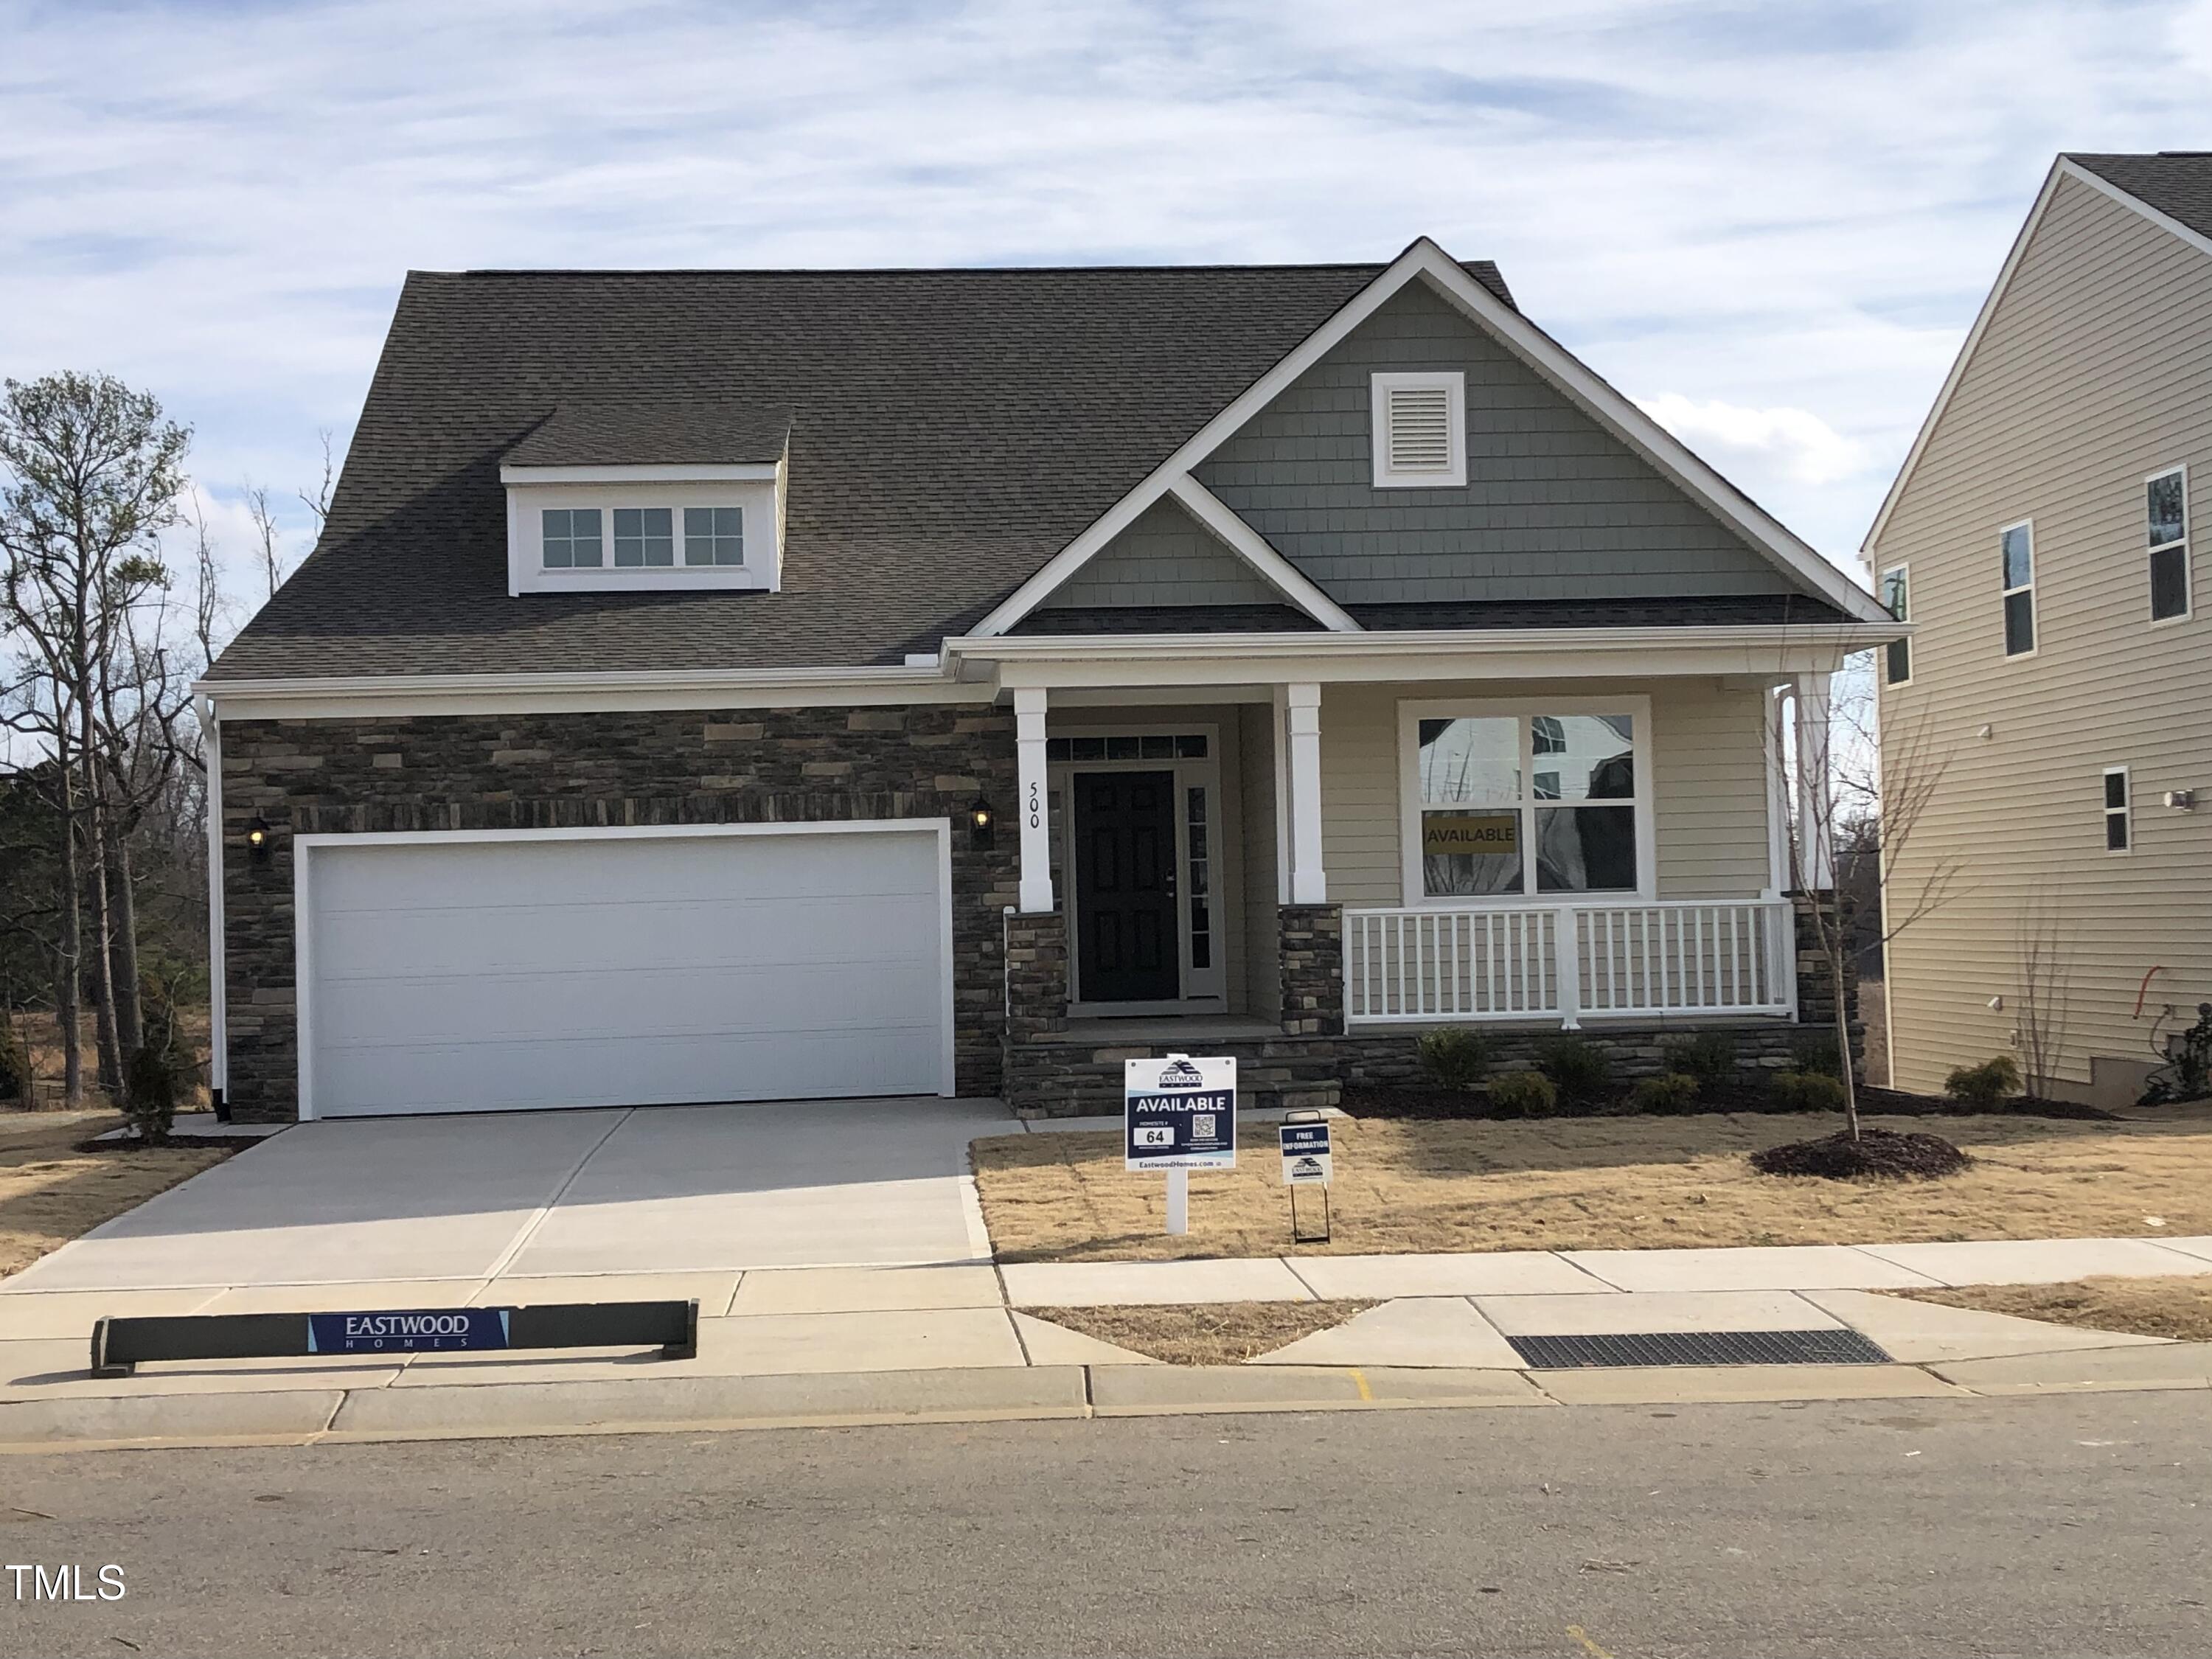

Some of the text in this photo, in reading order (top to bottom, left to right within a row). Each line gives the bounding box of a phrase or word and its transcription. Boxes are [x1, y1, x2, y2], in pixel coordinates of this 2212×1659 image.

[1029, 782, 1039, 829] 500
[1427, 828, 1516, 843] AVAILABLE
[1136, 1096, 1225, 1112] AVAILABLE
[1147, 1130, 1164, 1143] 64
[1296, 1132, 1313, 1140] FREE
[1283, 1141, 1328, 1150] INFORMATION
[346, 1315, 469, 1335] EASTWOOD
[346, 1338, 467, 1348] HOMES
